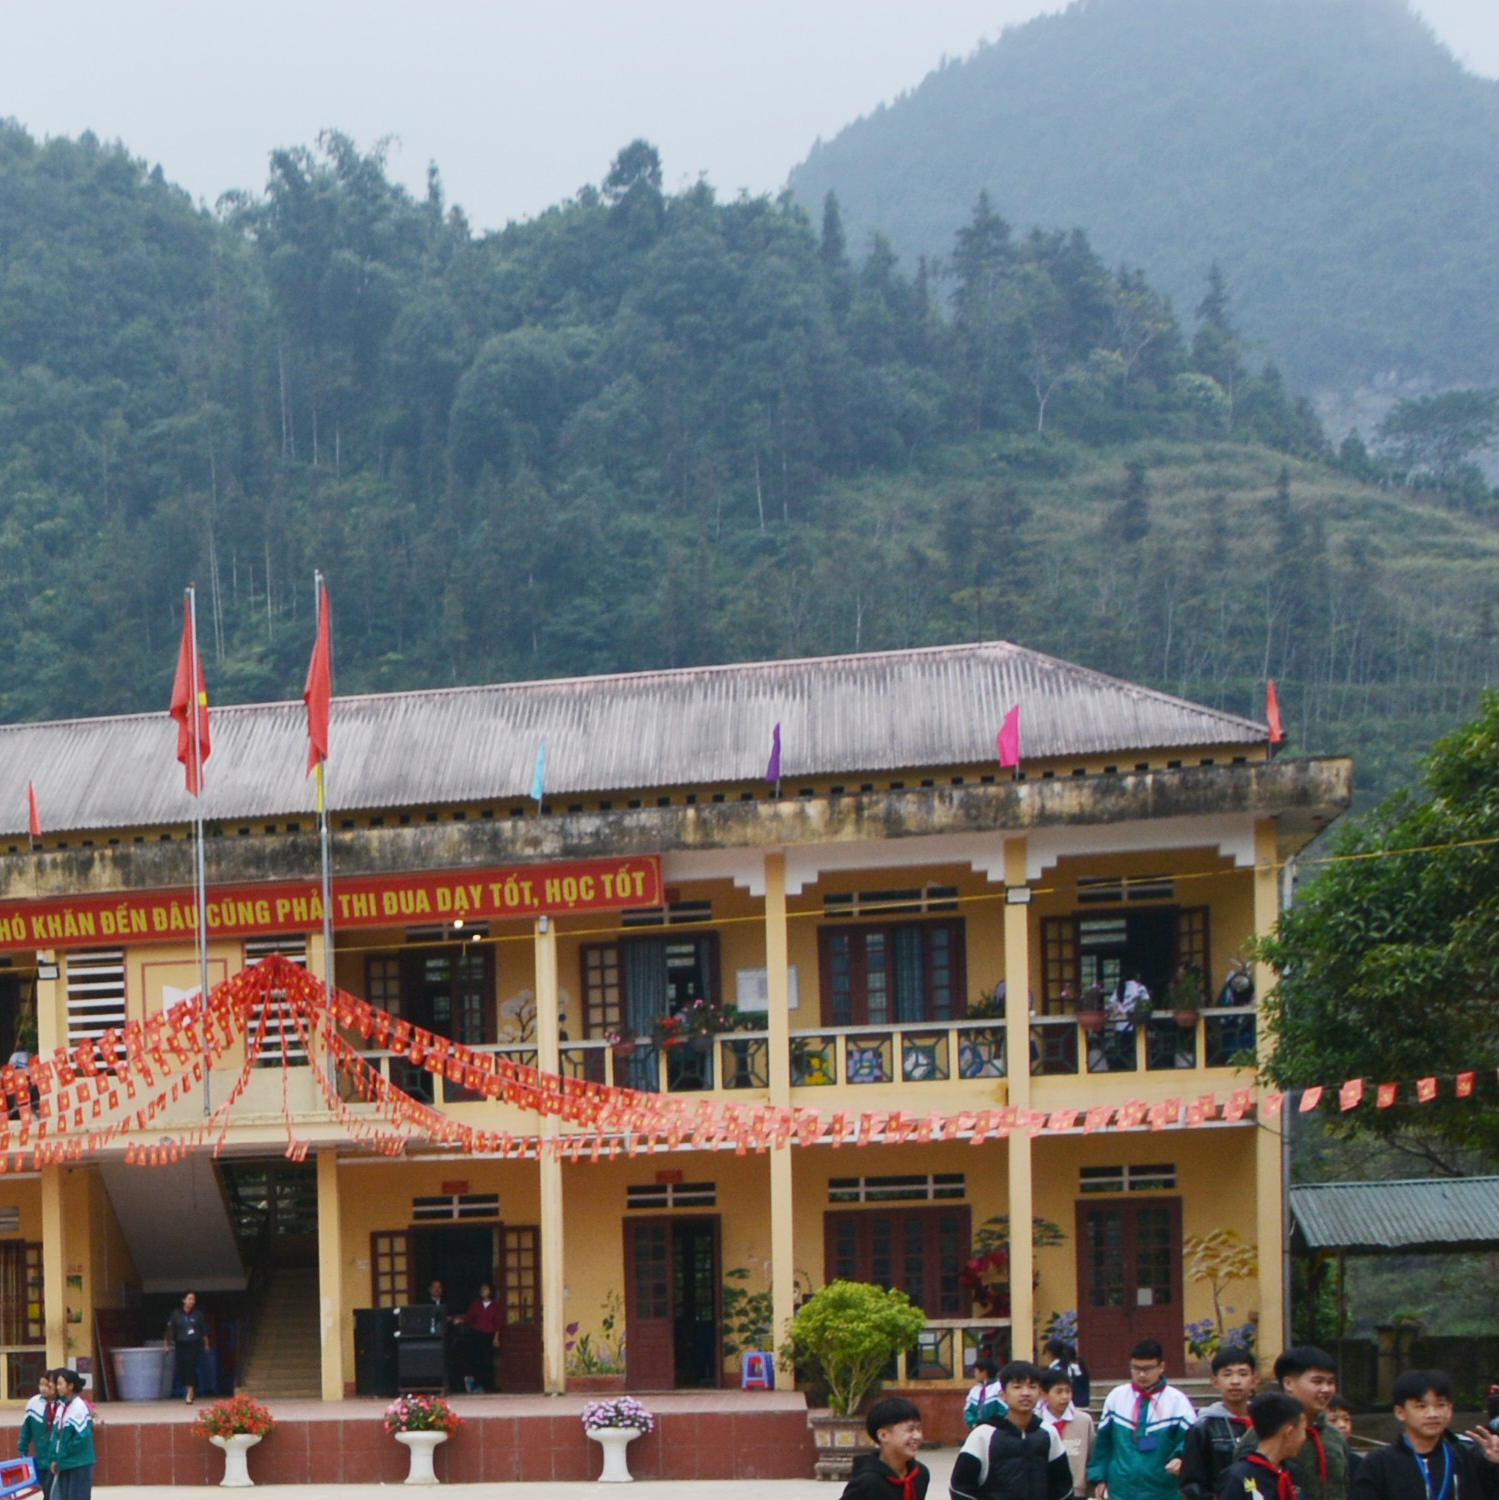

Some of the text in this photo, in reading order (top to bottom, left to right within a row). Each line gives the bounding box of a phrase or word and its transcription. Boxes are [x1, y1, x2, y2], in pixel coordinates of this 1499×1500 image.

[31, 907, 96, 939] KHĂN
[99, 901, 148, 935] ĐẾN
[152, 901, 200, 931] ĐÂU
[207, 896, 271, 928] CŨNG
[338, 893, 377, 919] THI
[382, 887, 432, 917] ĐUA
[436, 884, 483, 915] DẠY
[489, 873, 539, 908] TỐT,
[545, 874, 596, 908] HỌC
[600, 863, 646, 899] TỐT
